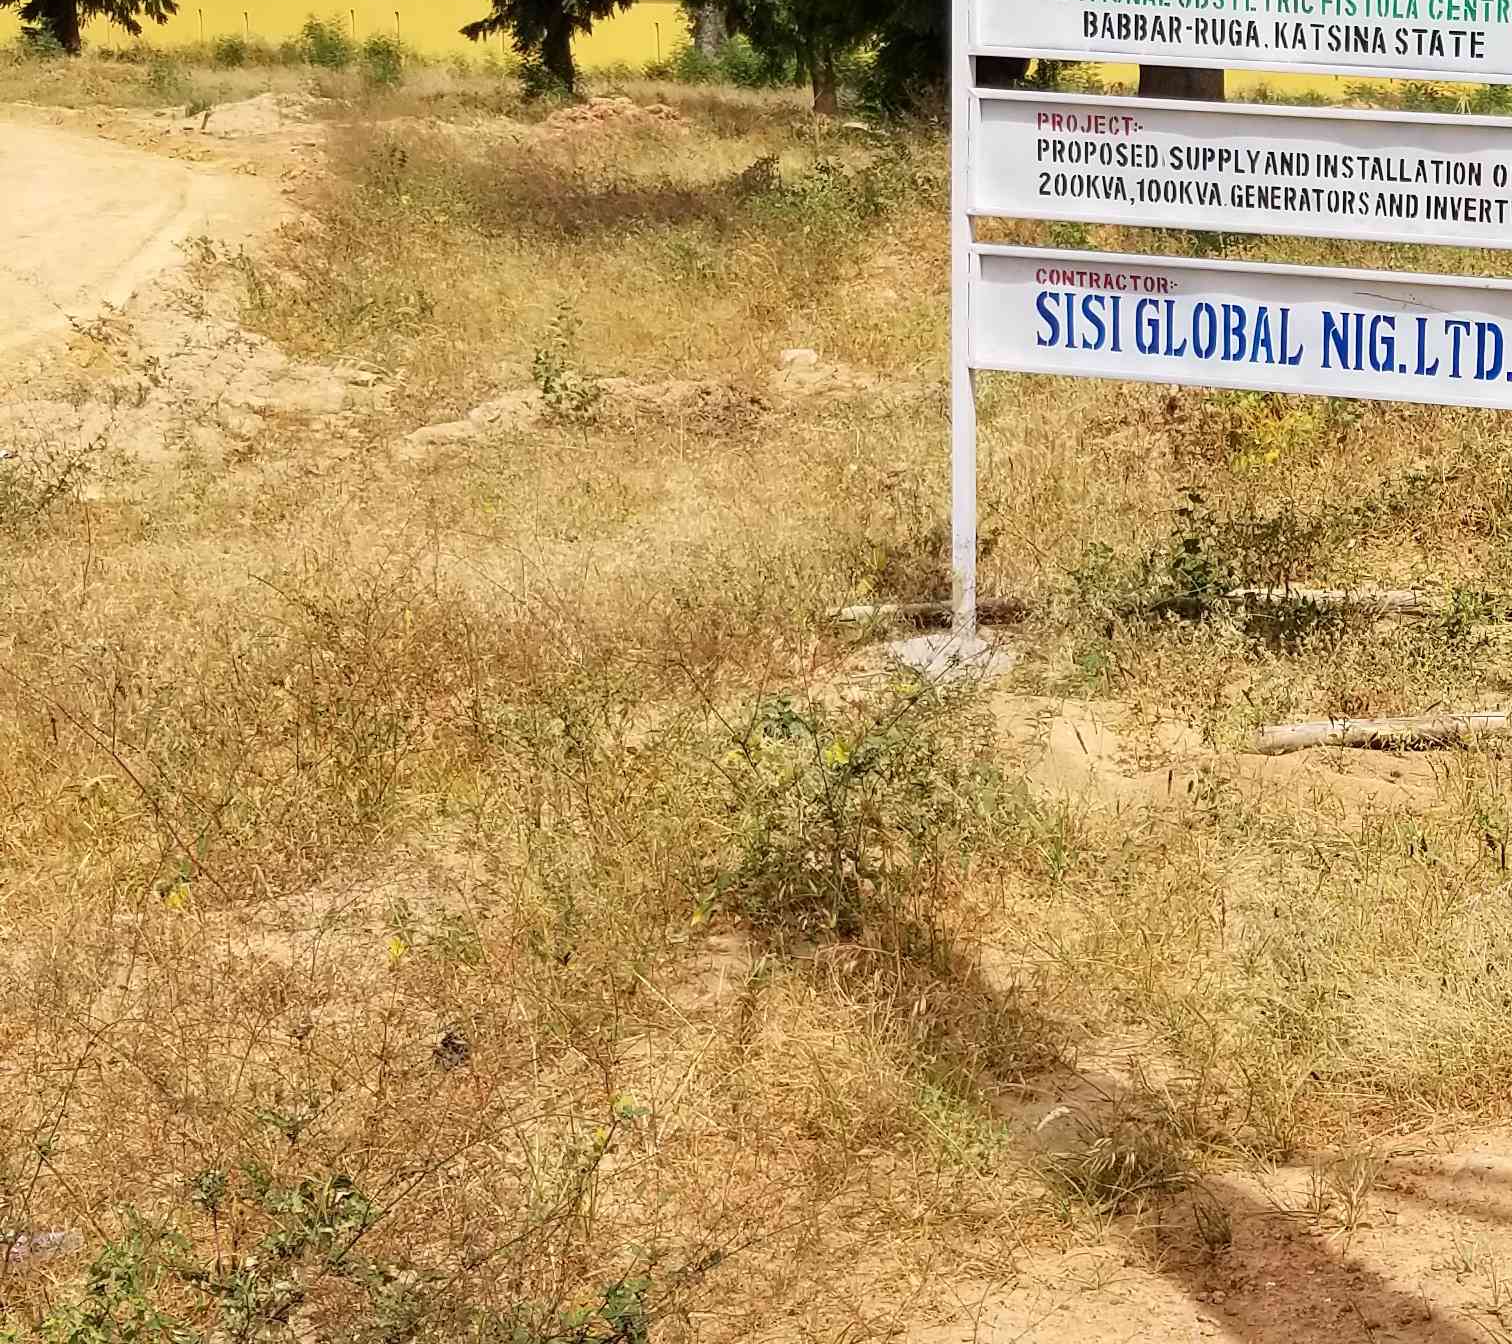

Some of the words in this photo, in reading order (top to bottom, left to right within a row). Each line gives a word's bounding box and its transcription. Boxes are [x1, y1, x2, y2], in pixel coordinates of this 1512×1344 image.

[1275, 21, 1387, 55] KATSINA
[1394, 28, 1485, 59] STATE
[1037, 138, 1158, 169] PROPOSED
[1169, 146, 1260, 174] SUPPLY
[1264, 151, 1310, 177] AND
[1316, 154, 1482, 187] INSTALLATION
[1230, 184, 1370, 215] GENERATORS
[1375, 192, 1419, 219] AND
[1035, 290, 1122, 352] SISI
[1135, 298, 1304, 366] GLOBAL
